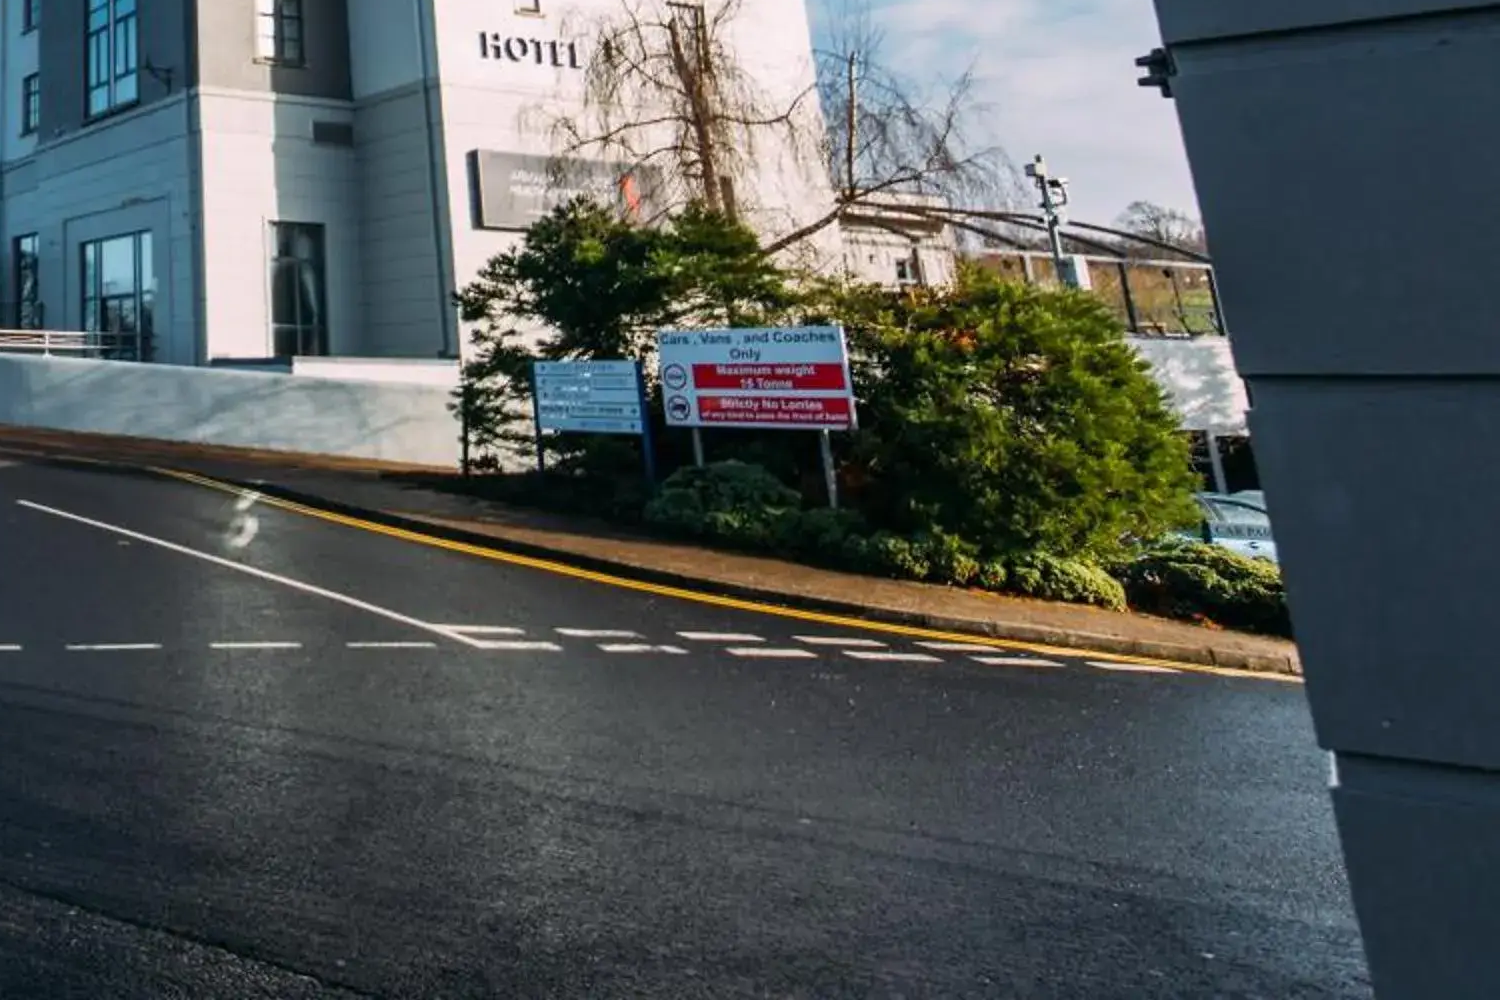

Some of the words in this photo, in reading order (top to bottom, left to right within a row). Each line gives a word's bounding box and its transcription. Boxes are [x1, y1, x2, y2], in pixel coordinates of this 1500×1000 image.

[479, 32, 582, 69] HOTEL
[660, 332, 690, 346] Cars
[701, 333, 732, 345] Vans
[743, 331, 769, 344] and
[773, 330, 836, 344] Coaches
[729, 348, 762, 362] Only
[716, 364, 773, 376] Maximum
